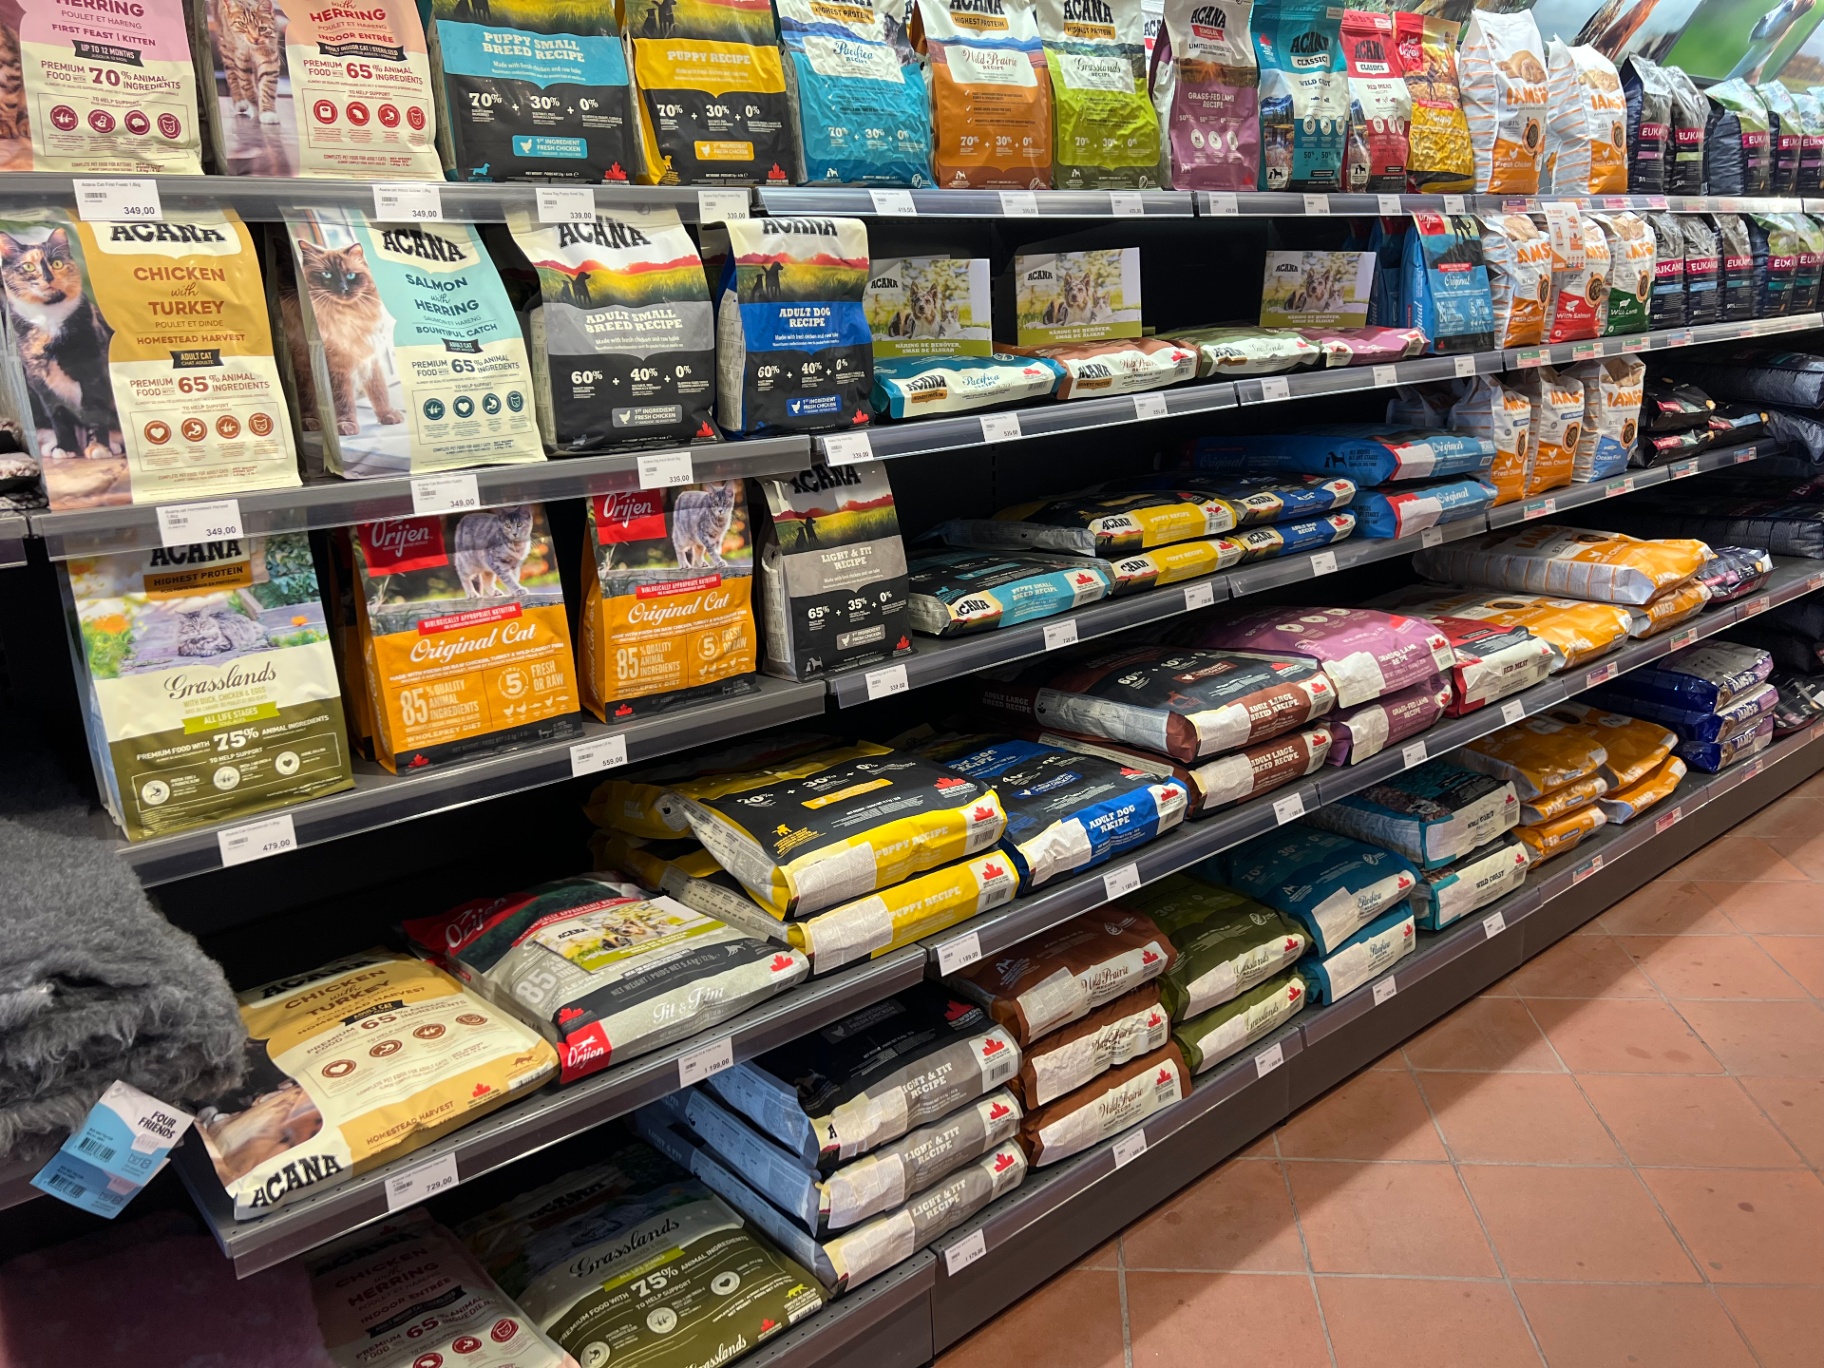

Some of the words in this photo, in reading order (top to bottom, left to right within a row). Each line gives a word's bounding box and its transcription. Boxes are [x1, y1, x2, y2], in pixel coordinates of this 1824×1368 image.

[61, 10, 95, 22] POULET
[96, 15, 106, 23] ET
[108, 18, 142, 30] HARENG
[309, 9, 386, 23] HERRING
[1063, 0, 1114, 24] ACANA
[1191, 6, 1226, 28] ACANA
[954, 15, 979, 26] HIGHEST
[981, 19, 1005, 28] PROTEIN
[51, 24, 79, 34] FIRST
[84, 28, 113, 40] FEAST
[122, 35, 156, 46] KITTEN
[318, 33, 356, 42] INDOOR
[359, 33, 394, 43] ENTRÉE
[483, 32, 531, 48] PUPPY
[534, 39, 580, 51] SMALL
[91, 45, 99, 53] TO
[110, 47, 135, 59] MONTHS
[482, 42, 532, 57] BREED
[535, 49, 585, 62] RECIPE
[667, 50, 708, 62] PUPPY
[710, 52, 751, 65] RECIPE
[833, 41, 874, 59] Pacifica
[41, 60, 85, 73] PREMIUM
[303, 60, 342, 69] PREMIUM
[384, 66, 413, 74] ANIMAL
[1074, 57, 1121, 73] Grasslands
[46, 71, 72, 81] FOOD
[133, 74, 167, 83] ANIMAL
[375, 74, 423, 85] INGREDIENTS
[123, 81, 181, 90] INGREDIENTS
[1188, 92, 1221, 100] GRASS-FED
[124, 206, 155, 216] 349,00
[412, 210, 437, 218] 349,00
[109, 223, 228, 243] ACANA
[381, 228, 468, 262] ACANA
[133, 267, 226, 282] CHICKEN
[1027, 269, 1053, 281] ACANA
[1275, 263, 1299, 273] ACANA
[405, 274, 468, 292] SALMON
[870, 276, 899, 290] ACANA
[148, 301, 224, 316] TURKEY
[414, 299, 480, 317] HERRING
[779, 308, 811, 318] ADULT
[812, 307, 831, 316] DOG
[155, 320, 186, 328] POULET
[187, 320, 197, 328] ET
[199, 320, 224, 328] DINDE
[586, 310, 630, 324] ADULT
[632, 310, 676, 322] SMALL
[789, 316, 827, 328] RECIPE
[416, 326, 465, 337] BOUNTIFUL
[466, 324, 497, 335] CATCH
[584, 320, 633, 333] BREED
[635, 319, 683, 331] RECIPE
[136, 334, 199, 345] HOMESTEAD
[201, 333, 246, 343] HARVEST
[180, 352, 199, 362] ADULT
[200, 352, 212, 360] CAT
[411, 360, 448, 369] PREMIUM
[483, 354, 509, 365] ANIMAL
[417, 368, 438, 377] FOOD
[477, 362, 520, 373] INGREDIENTS
[802, 361, 822, 374] 40%
[836, 358, 848, 370] 0%
[130, 378, 174, 388] PREMIUM
[221, 373, 256, 382] ANIMAL
[962, 372, 1001, 388] Pacifica
[136, 387, 161, 396] FOOD
[212, 381, 270, 392] INGREDIENTS
[450, 498, 475, 508] 349,00
[1436, 487, 1470, 506] Original
[206, 526, 236, 536] 349,00
[821, 550, 850, 563] LIGHT
[851, 549, 858, 558] &
[860, 546, 872, 556] FIT
[835, 557, 867, 570] RECIPE
[154, 572, 198, 586] HIGHEST
[201, 566, 243, 579] PROTEIN
[628, 596, 701, 626] Original
[703, 592, 730, 612] Cat
[807, 606, 830, 619] 65%
[848, 598, 868, 611] 35%
[879, 590, 892, 603] 0%
[409, 628, 498, 663] Original
[501, 621, 536, 641] Cat
[531, 661, 556, 675] FRESH
[616, 647, 639, 679] 85
[640, 661, 680, 677] INGREDIENTS
[1515, 659, 1529, 671] MEAT
[163, 660, 277, 700] Grasslands
[505, 672, 522, 693] 5
[400, 687, 429, 726] 85
[430, 700, 480, 720] INGREDIENTS
[1404, 707, 1421, 718] RECIPE
[204, 715, 214, 724] ALL
[215, 713, 231, 723] LIFE
[233, 707, 258, 720] STAGES
[262, 724, 287, 736] ANIMAL
[287, 715, 330, 730] INGREDIENTS
[213, 727, 260, 751] 75%
[136, 747, 171, 761] PREMIUM
[170, 744, 192, 754] FOOD
[192, 740, 210, 749] WITH
[1272, 746, 1294, 758] LARGE
[1089, 810, 1116, 829] ADULT
[1117, 804, 1136, 818] DOG
[1100, 815, 1130, 834] RECIPE
[262, 839, 291, 852] 479,00
[875, 840, 909, 859] PUPPY
[912, 826, 949, 845] RECIPE
[890, 900, 923, 920] PUPPY
[925, 886, 961, 903] RECIPE
[1101, 965, 1129, 985] Prairie
[285, 970, 387, 1010] CHICKEN
[306, 980, 390, 1016] TURKEY
[1100, 1097, 1119, 1118] Wild
[151, 1110, 177, 1128] FOUR
[365, 1117, 419, 1146] HOMESTEAD
[419, 1100, 455, 1122] HARVEST
[137, 1116, 176, 1140] FRIENDS
[904, 1140, 933, 1162] LIGHT
[935, 1136, 943, 1145] &
[944, 1126, 960, 1141] FIT
[917, 1140, 953, 1165] RECIPE
[248, 1154, 345, 1209] ACANA
[425, 1176, 453, 1192] 729,00
[912, 1193, 941, 1217] LIGHT
[943, 1188, 951, 1198] &
[951, 1179, 966, 1194] FIT
[926, 1193, 960, 1220] RECIPE
[569, 1218, 680, 1278] Grasslands
[630, 1266, 679, 1299] 75%
